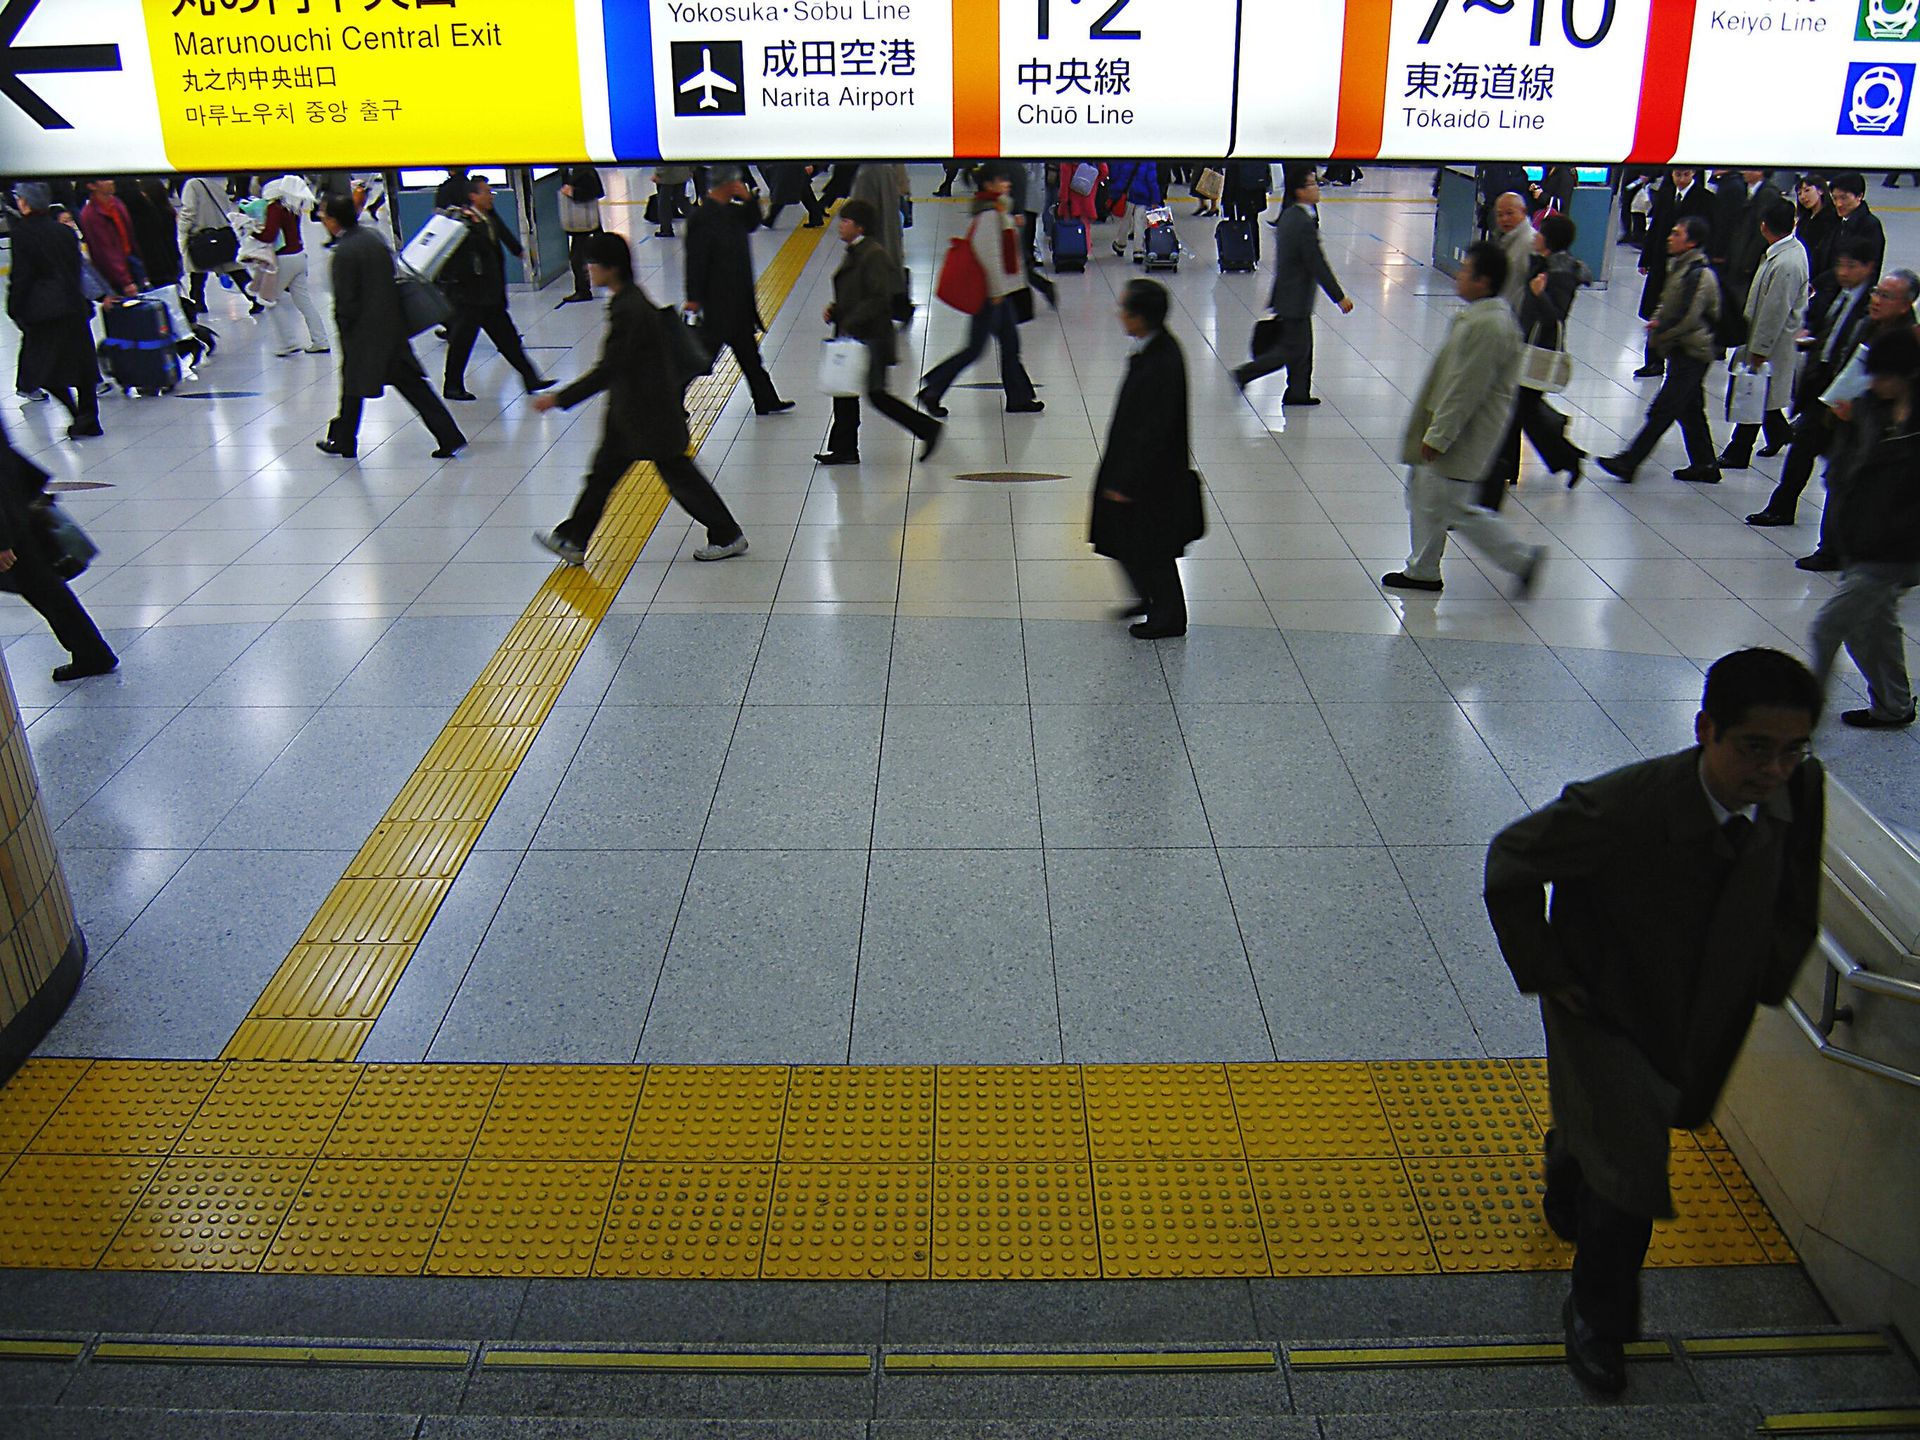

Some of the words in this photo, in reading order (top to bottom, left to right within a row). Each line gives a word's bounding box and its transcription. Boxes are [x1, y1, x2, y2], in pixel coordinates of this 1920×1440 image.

[863, 0, 910, 20] Line
[1711, 10, 1772, 35] Keiyō
[1781, 12, 1827, 32] Line
[174, 27, 332, 56] Marunouchi
[342, 25, 440, 51] Central
[450, 23, 502, 48] Exit
[762, 39, 916, 78] 成田空港
[182, 65, 337, 93] 丸之内中央出口
[1018, 57, 1131, 96] 中央線
[1404, 61, 1555, 102] 東海道線
[762, 88, 830, 107] Narita
[838, 86, 915, 110] Airport
[185, 102, 295, 127] 마루노우치
[306, 100, 348, 124] 중앙
[360, 99, 402, 122] 출구
[1017, 104, 1078, 125] Chūō
[1087, 104, 1134, 124] Line
[1402, 107, 1490, 129] Tōkaidō
[1499, 110, 1545, 130] Line
